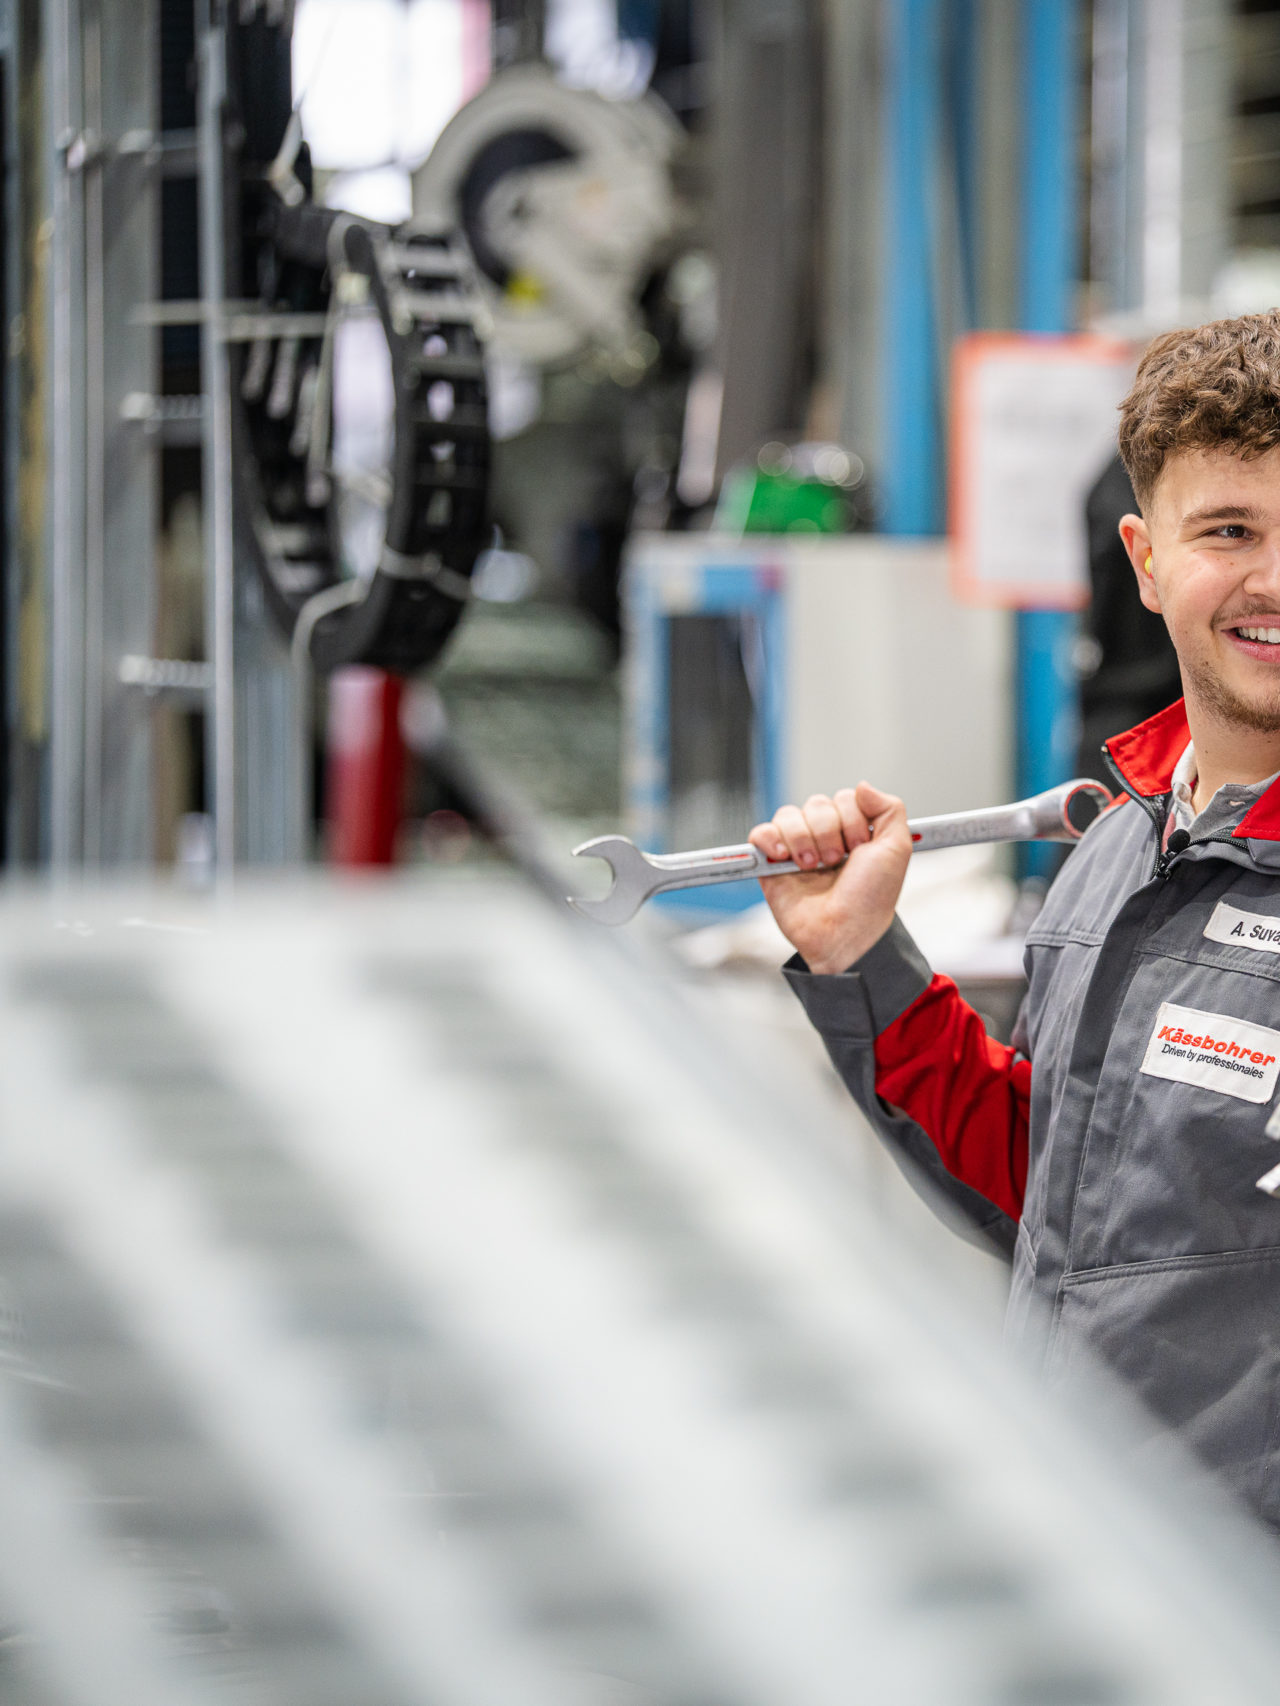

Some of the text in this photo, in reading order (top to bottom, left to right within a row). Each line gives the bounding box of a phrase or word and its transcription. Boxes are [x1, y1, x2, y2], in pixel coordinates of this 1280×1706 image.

[1230, 921, 1246, 937] A.
[1157, 1025, 1276, 1067] Kässbohrer
[1161, 1043, 1187, 1059] Driven
[1186, 1049, 1198, 1062] by
